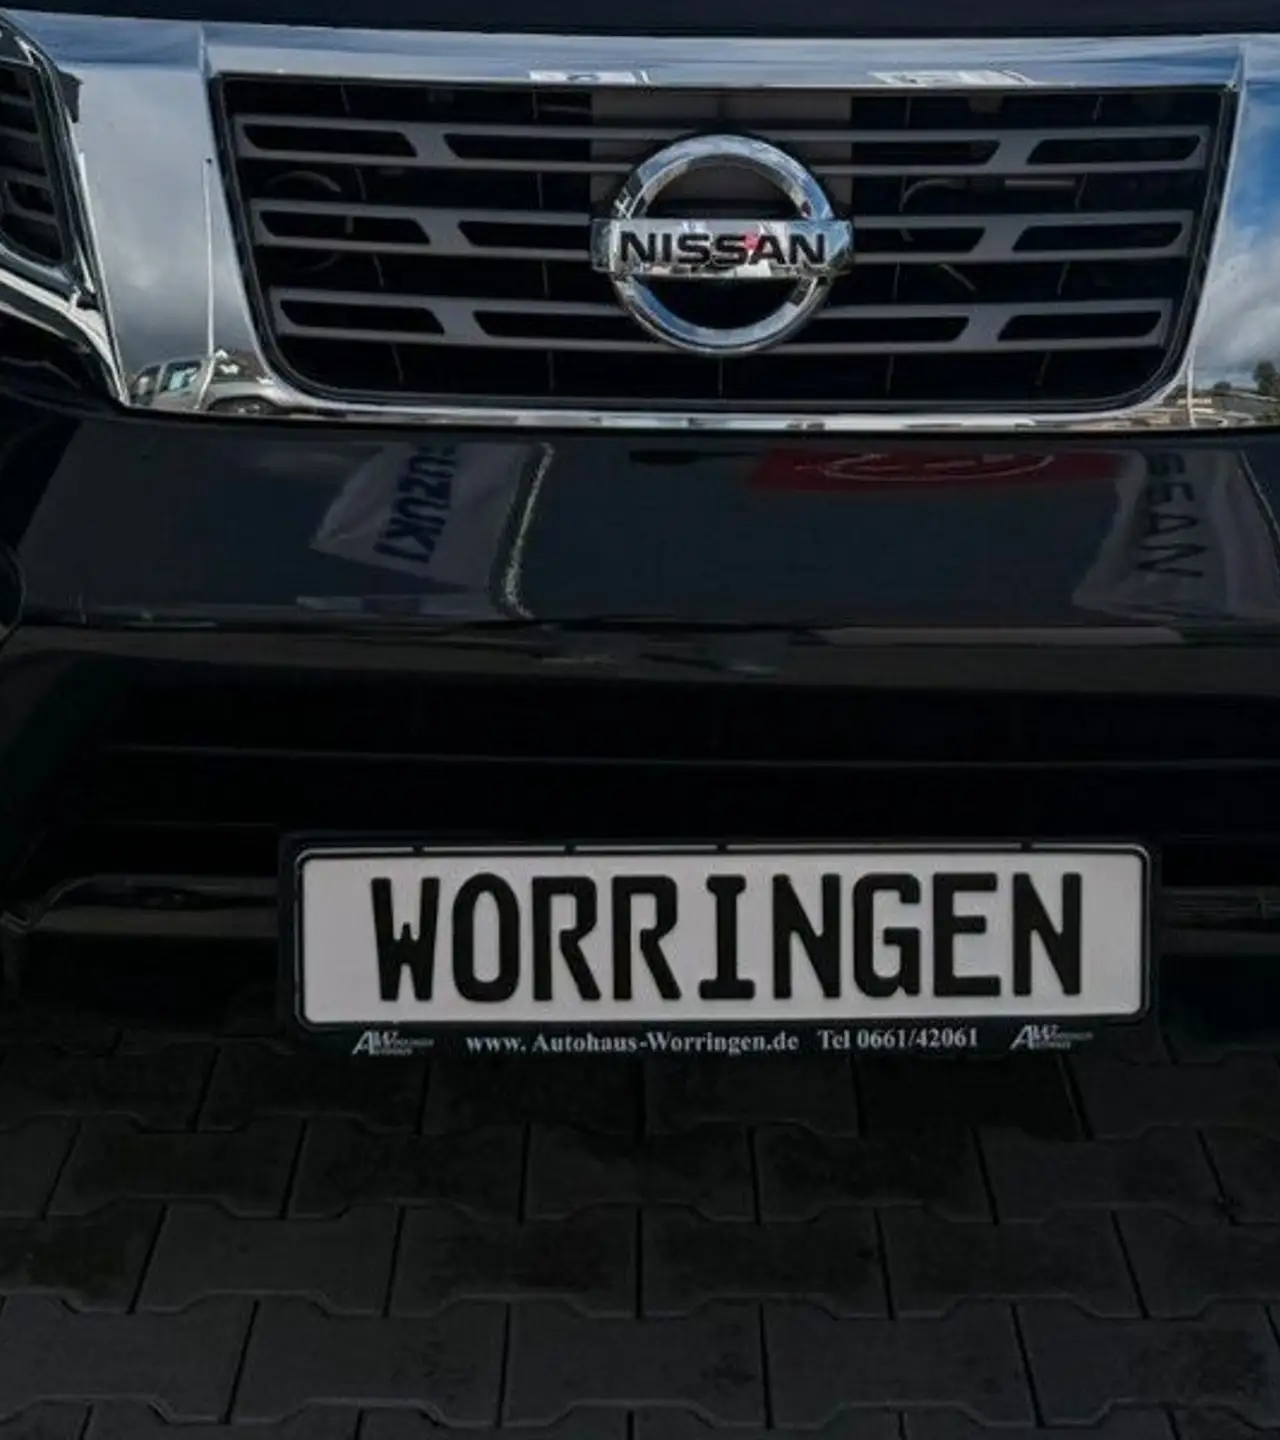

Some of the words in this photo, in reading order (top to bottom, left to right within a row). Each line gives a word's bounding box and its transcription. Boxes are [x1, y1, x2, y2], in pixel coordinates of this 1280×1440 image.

[620, 232, 824, 266] NISSAN
[371, 872, 1084, 1002] WORRINGEN
[817, 1028, 850, 1050] Tel
[856, 1026, 979, 1050] 0661/42061
